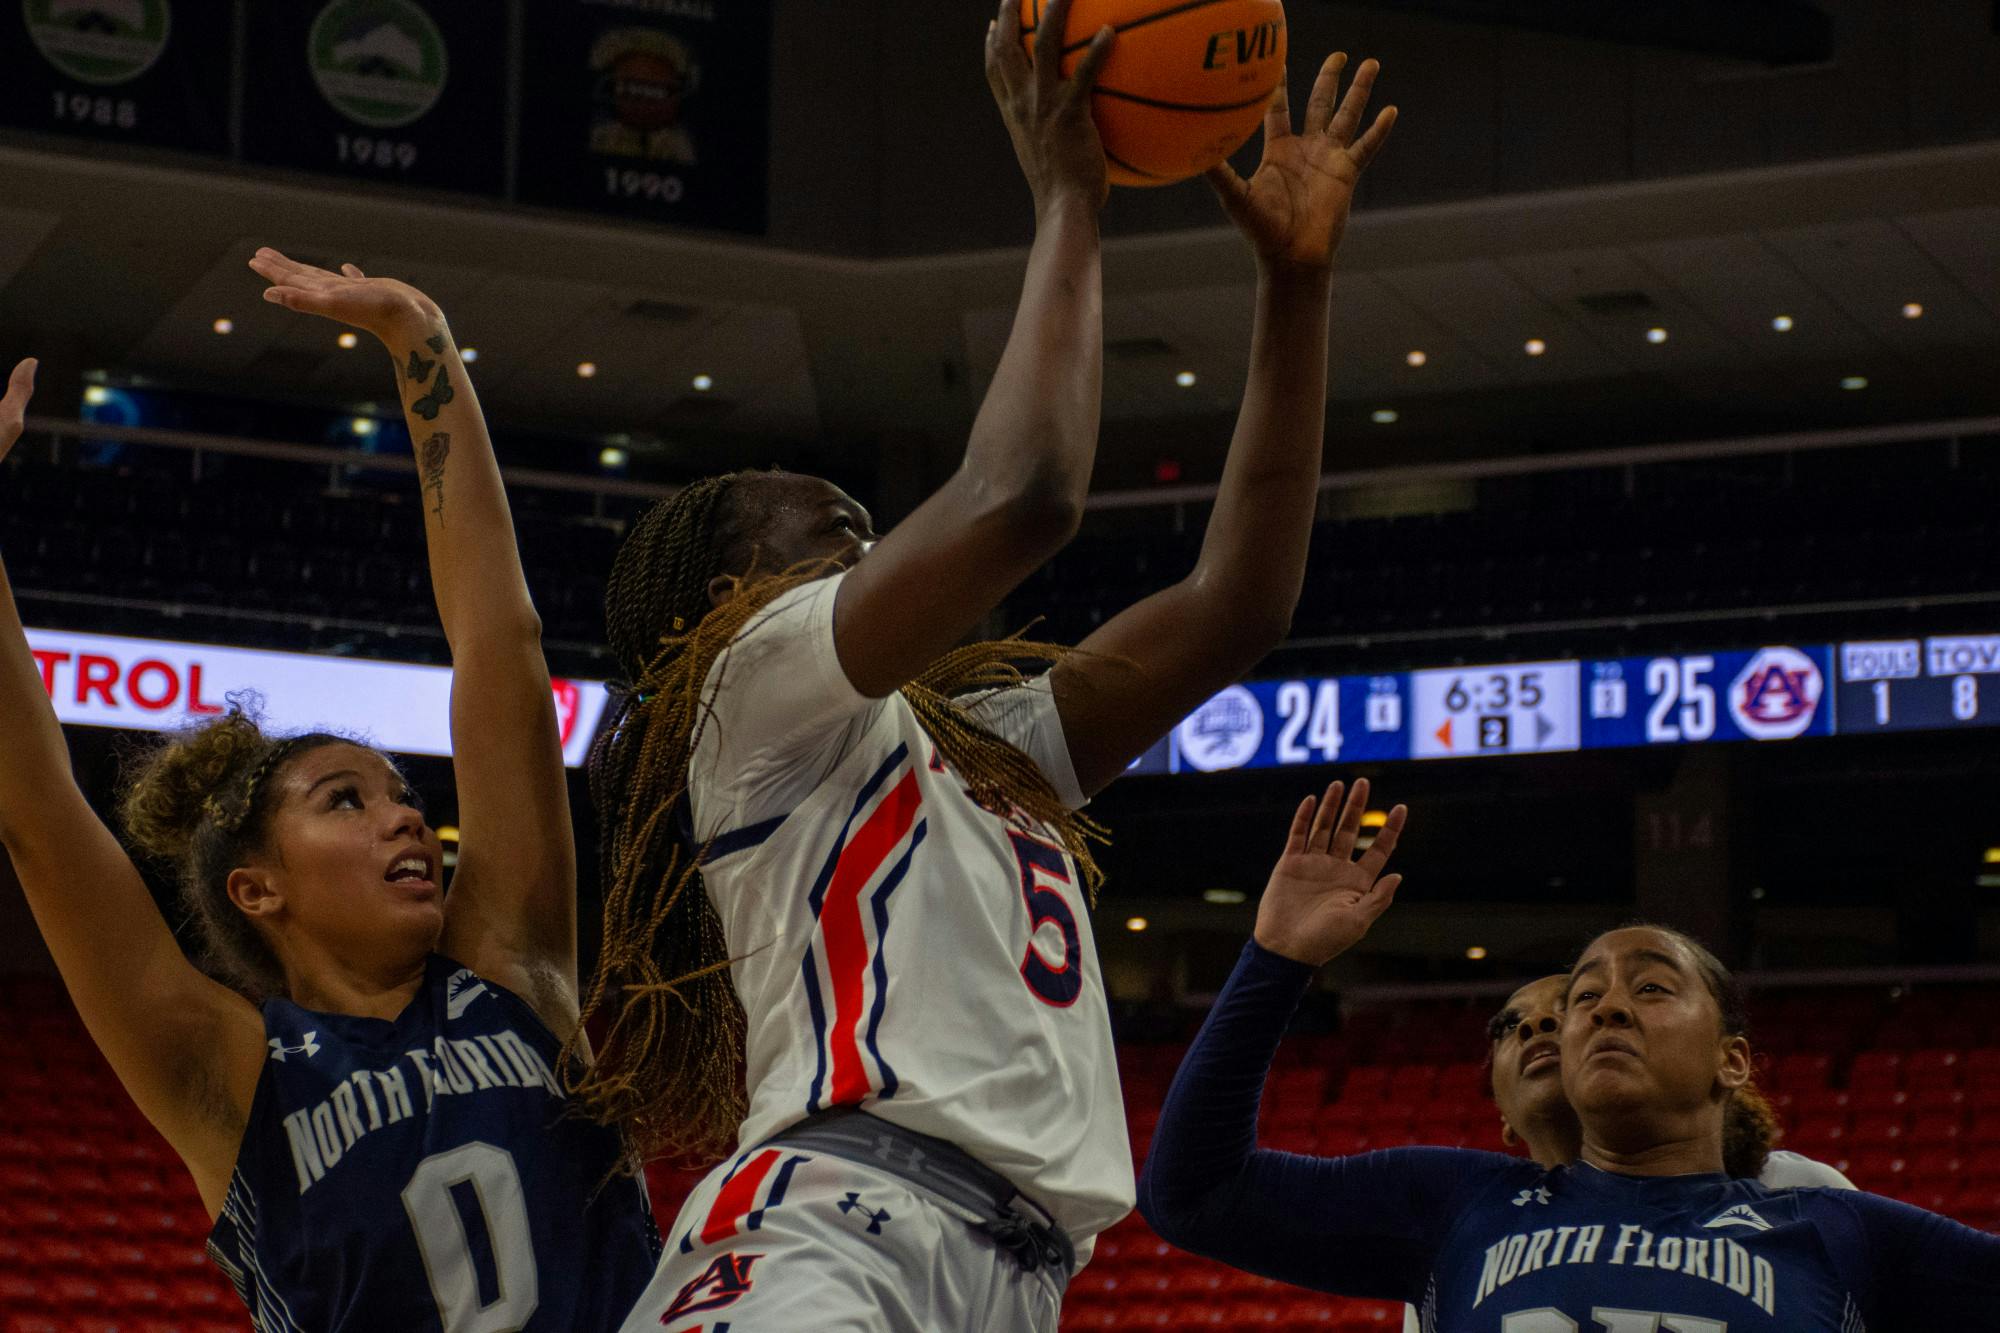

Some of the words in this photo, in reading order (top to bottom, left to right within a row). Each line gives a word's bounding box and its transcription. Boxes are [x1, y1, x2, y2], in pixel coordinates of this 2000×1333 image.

[52, 90, 137, 129] 1988
[335, 132, 418, 170] 1989
[605, 167, 685, 203] 1990
[32, 650, 224, 714] TROL
[1849, 650, 1913, 672] FOULS
[1446, 672, 1544, 713] 6:35
[1645, 655, 1716, 743] 25
[1872, 680, 1890, 725] 1
[1952, 673, 1978, 721] 8
[1275, 678, 1344, 765] 24
[1484, 719, 1503, 747] 2
[1007, 827, 1082, 1009] 5
[282, 1065, 414, 1198] NORTH
[400, 1140, 540, 1333] 0
[1472, 1224, 1607, 1311] NORTH
[1608, 1222, 1776, 1317] FLORIDA
